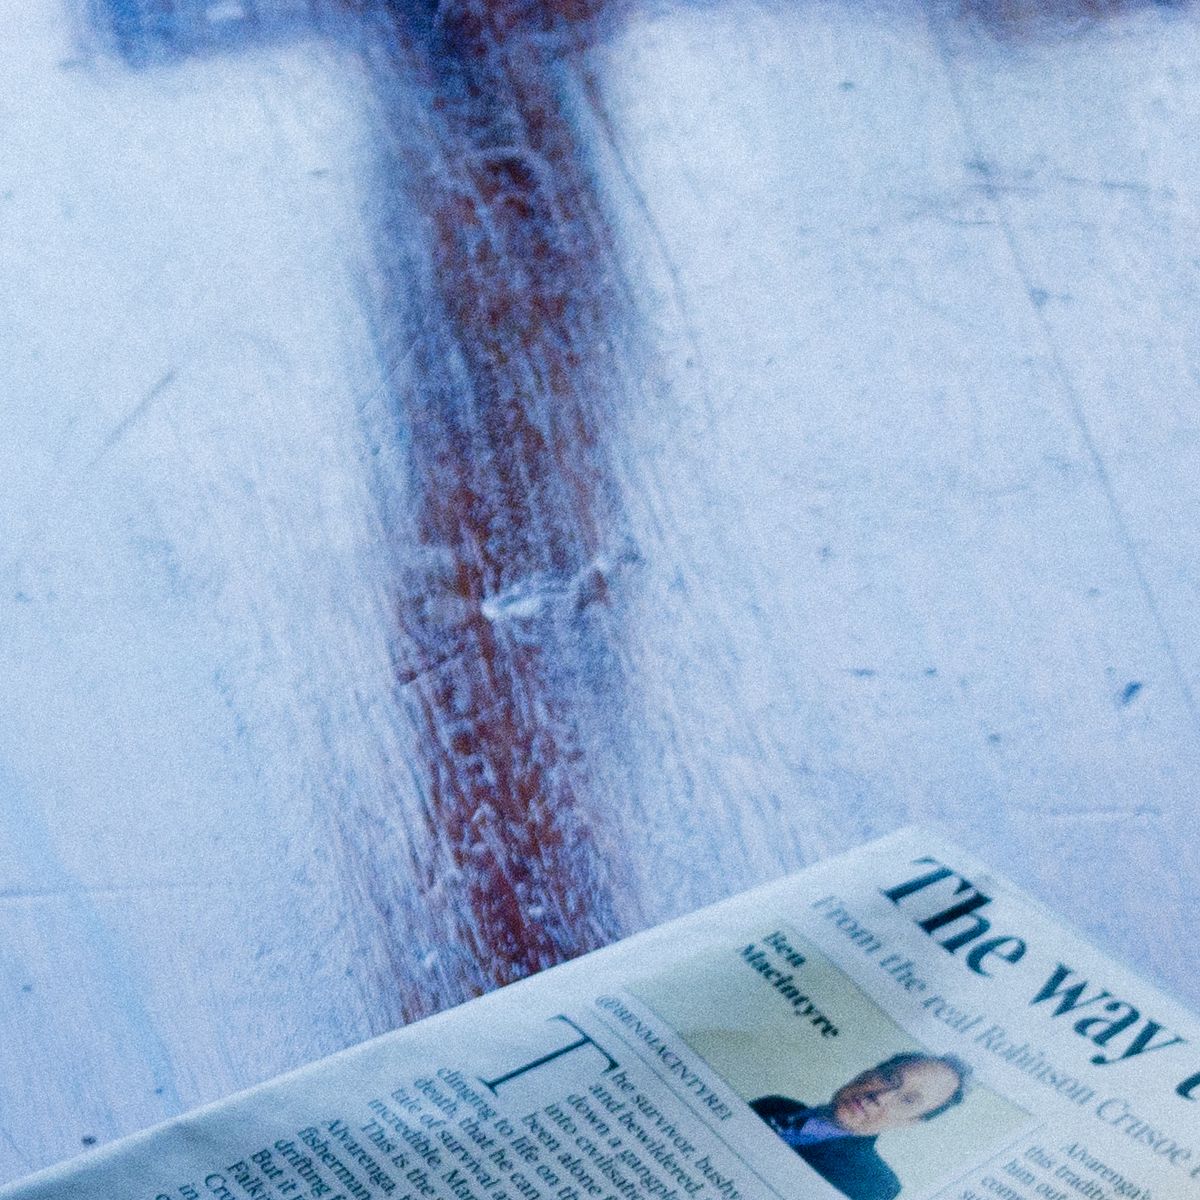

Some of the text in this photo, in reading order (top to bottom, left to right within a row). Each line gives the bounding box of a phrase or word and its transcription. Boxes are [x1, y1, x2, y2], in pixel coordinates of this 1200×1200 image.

[737, 942, 840, 1040] Macintyre
[761, 928, 808, 970] Ben
[880, 857, 1027, 978] The
[1028, 962, 1187, 1067] way
[881, 947, 929, 996] the
[927, 991, 982, 1036] real
[976, 1020, 1097, 1107] Robinson
[1094, 1097, 1192, 1169] Crusoe
[178, 1184, 199, 1200] in
